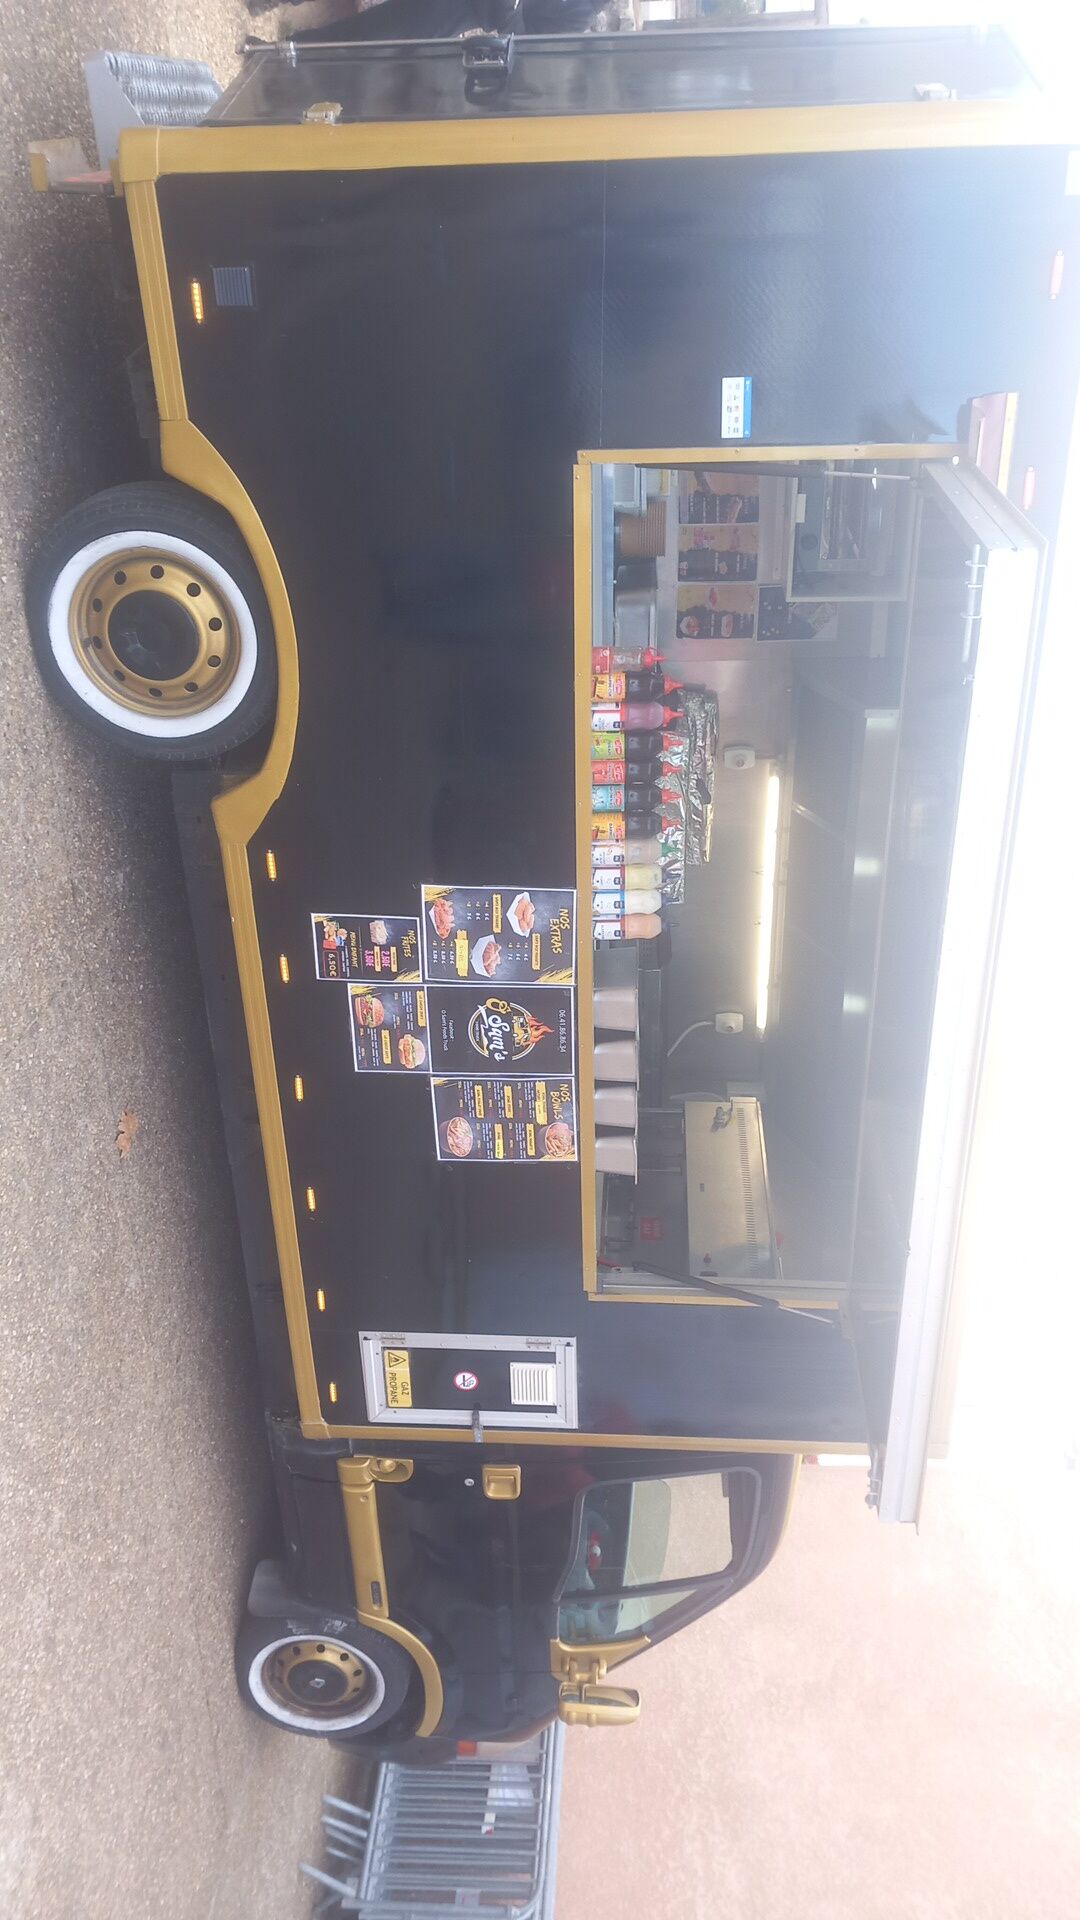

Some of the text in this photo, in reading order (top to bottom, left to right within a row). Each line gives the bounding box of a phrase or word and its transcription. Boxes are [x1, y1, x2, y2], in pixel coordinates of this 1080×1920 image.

[560, 908, 570, 930] NOS
[401, 936, 412, 958] FRITES
[408, 930, 416, 944] NOS
[549, 918, 562, 954] EXTRAS
[328, 953, 337, 977] 6,50€
[350, 948, 358, 968] ENFANT
[364, 950, 374, 967] 3,50€
[381, 950, 390, 968] 2,50€
[488, 1015, 510, 1062] Sam's
[558, 1009, 566, 1053] 06.41.86.86.34
[560, 1084, 570, 1102] NOS
[550, 1091, 563, 1120] BOWLS
[389, 1372, 399, 1404] PROPANE
[401, 1382, 409, 1395] GAZ
